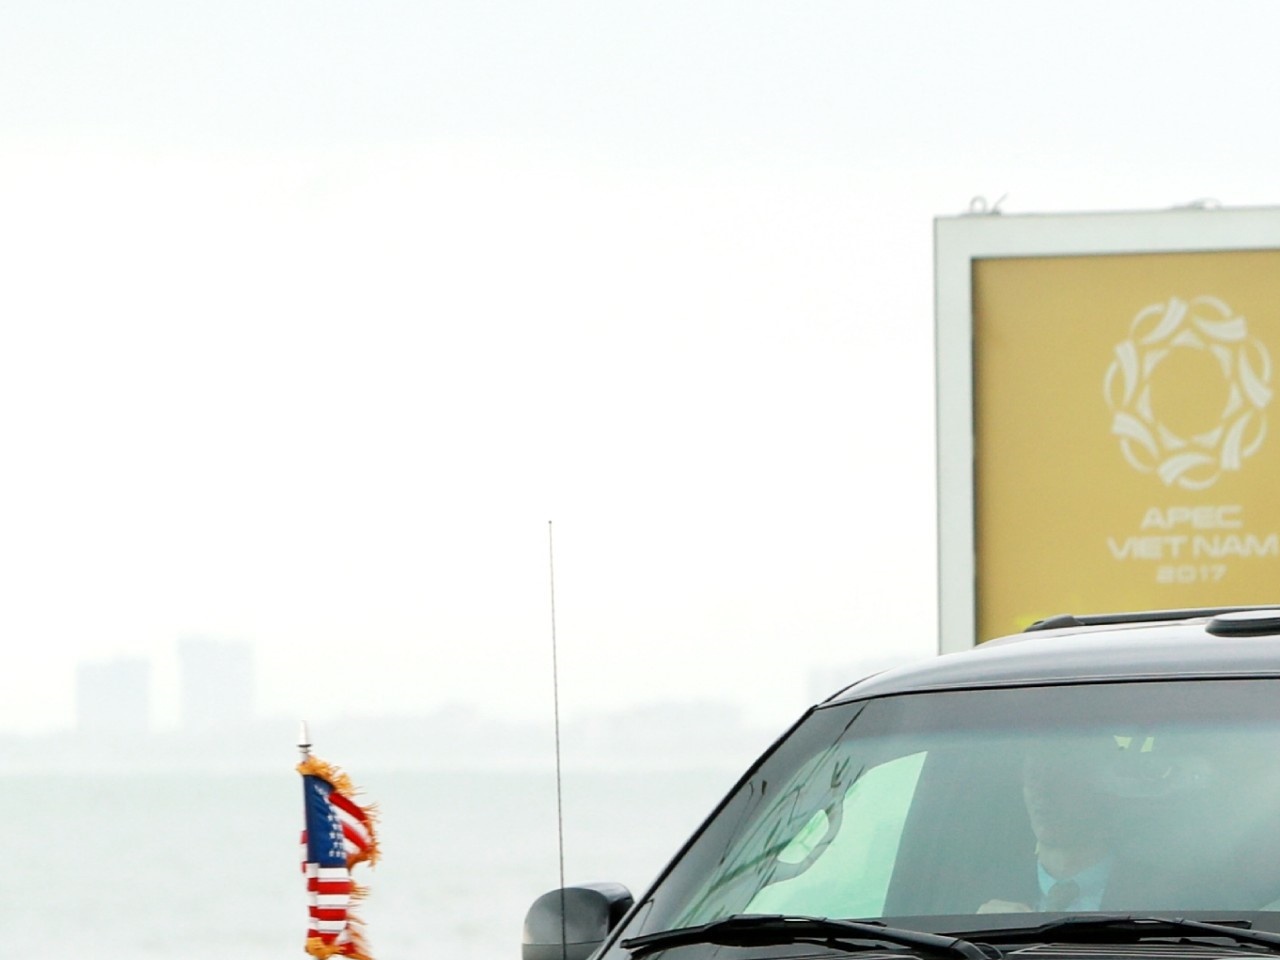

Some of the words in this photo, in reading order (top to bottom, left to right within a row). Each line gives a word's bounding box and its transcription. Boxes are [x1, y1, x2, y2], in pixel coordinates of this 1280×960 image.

[1141, 505, 1243, 530] APEC
[1106, 534, 1187, 560] VIET
[1191, 533, 1279, 558] NAM
[1156, 564, 1228, 584] 2017
